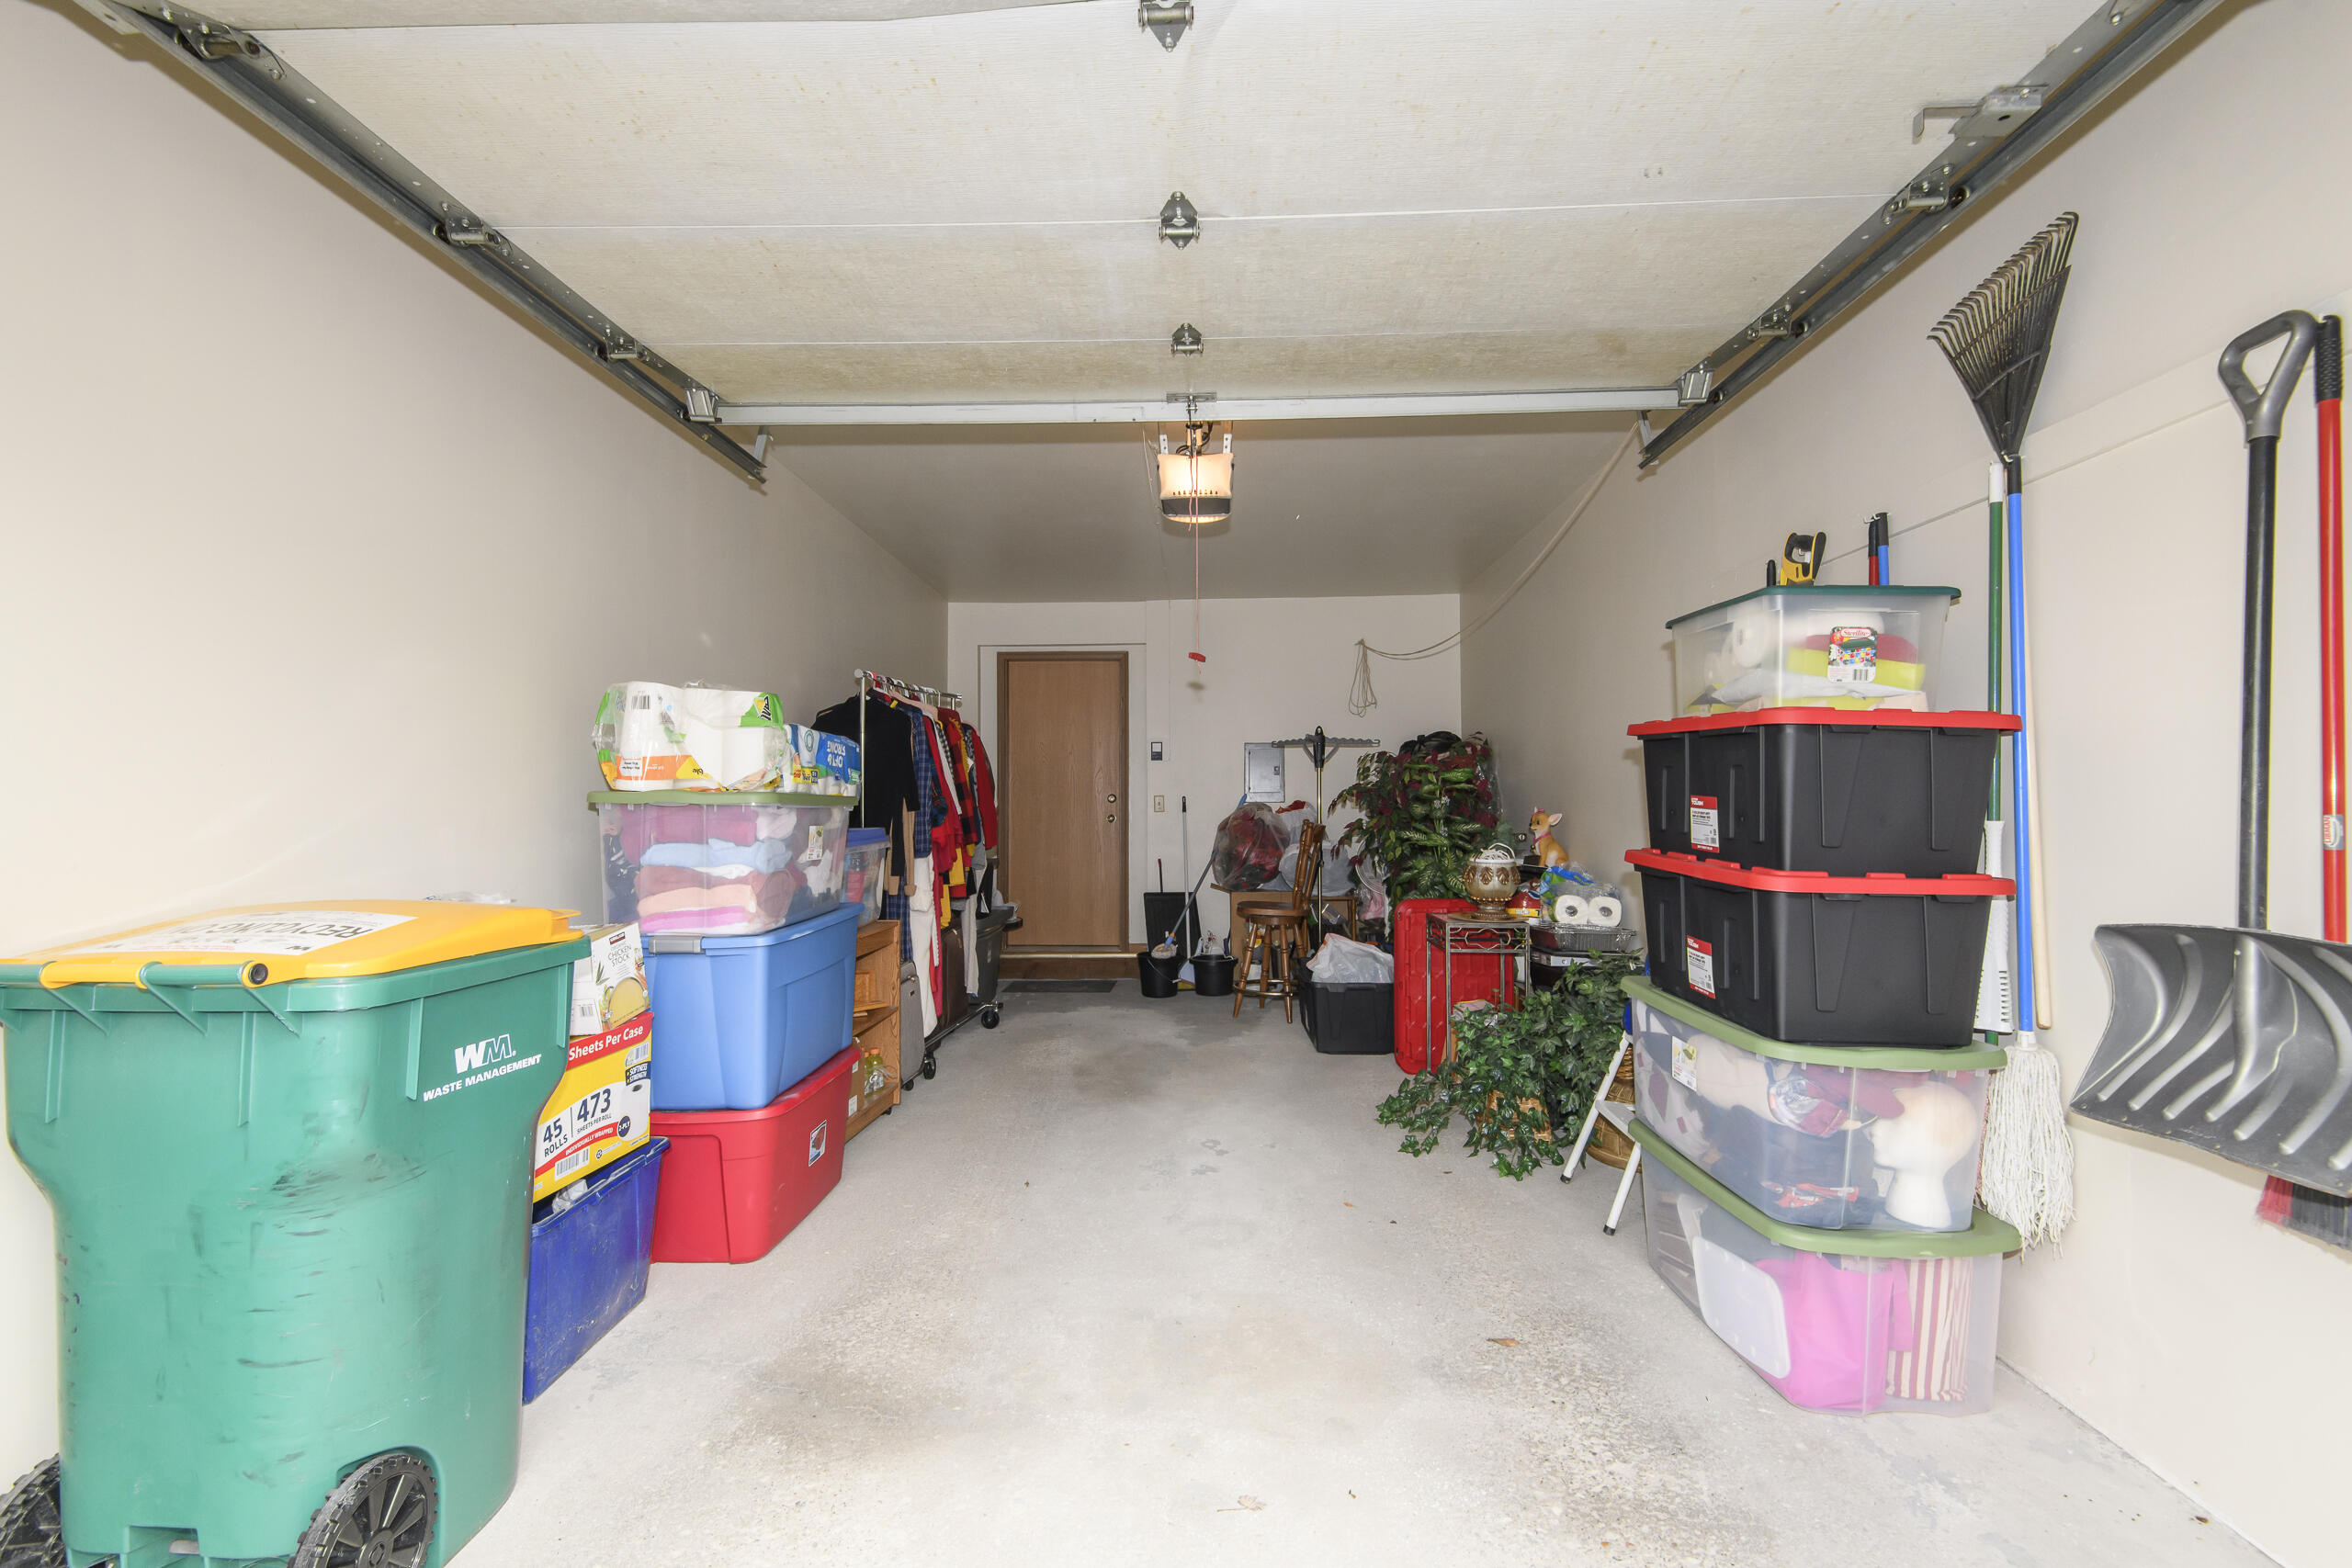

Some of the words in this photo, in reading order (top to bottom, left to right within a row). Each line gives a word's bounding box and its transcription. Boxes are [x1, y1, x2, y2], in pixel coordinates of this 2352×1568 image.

[608, 944, 631, 961] CHICKEN
[612, 953, 629, 967] STOCK
[454, 1033, 513, 1074] WM
[569, 1040, 604, 1061] Sheets
[605, 1033, 621, 1047] Per
[623, 1025, 643, 1041] Case
[423, 1080, 462, 1102] WASTE
[465, 1054, 542, 1088] MANAGEMENT
[577, 1088, 611, 1122] 473
[543, 1118, 563, 1143] 45
[577, 1122, 594, 1134] SHEETS
[602, 1112, 612, 1122] ROLL
[544, 1134, 568, 1157] ROLLS
[565, 1134, 594, 1156] INDIVIDUALLY
[594, 1126, 614, 1139] WRAPPED
